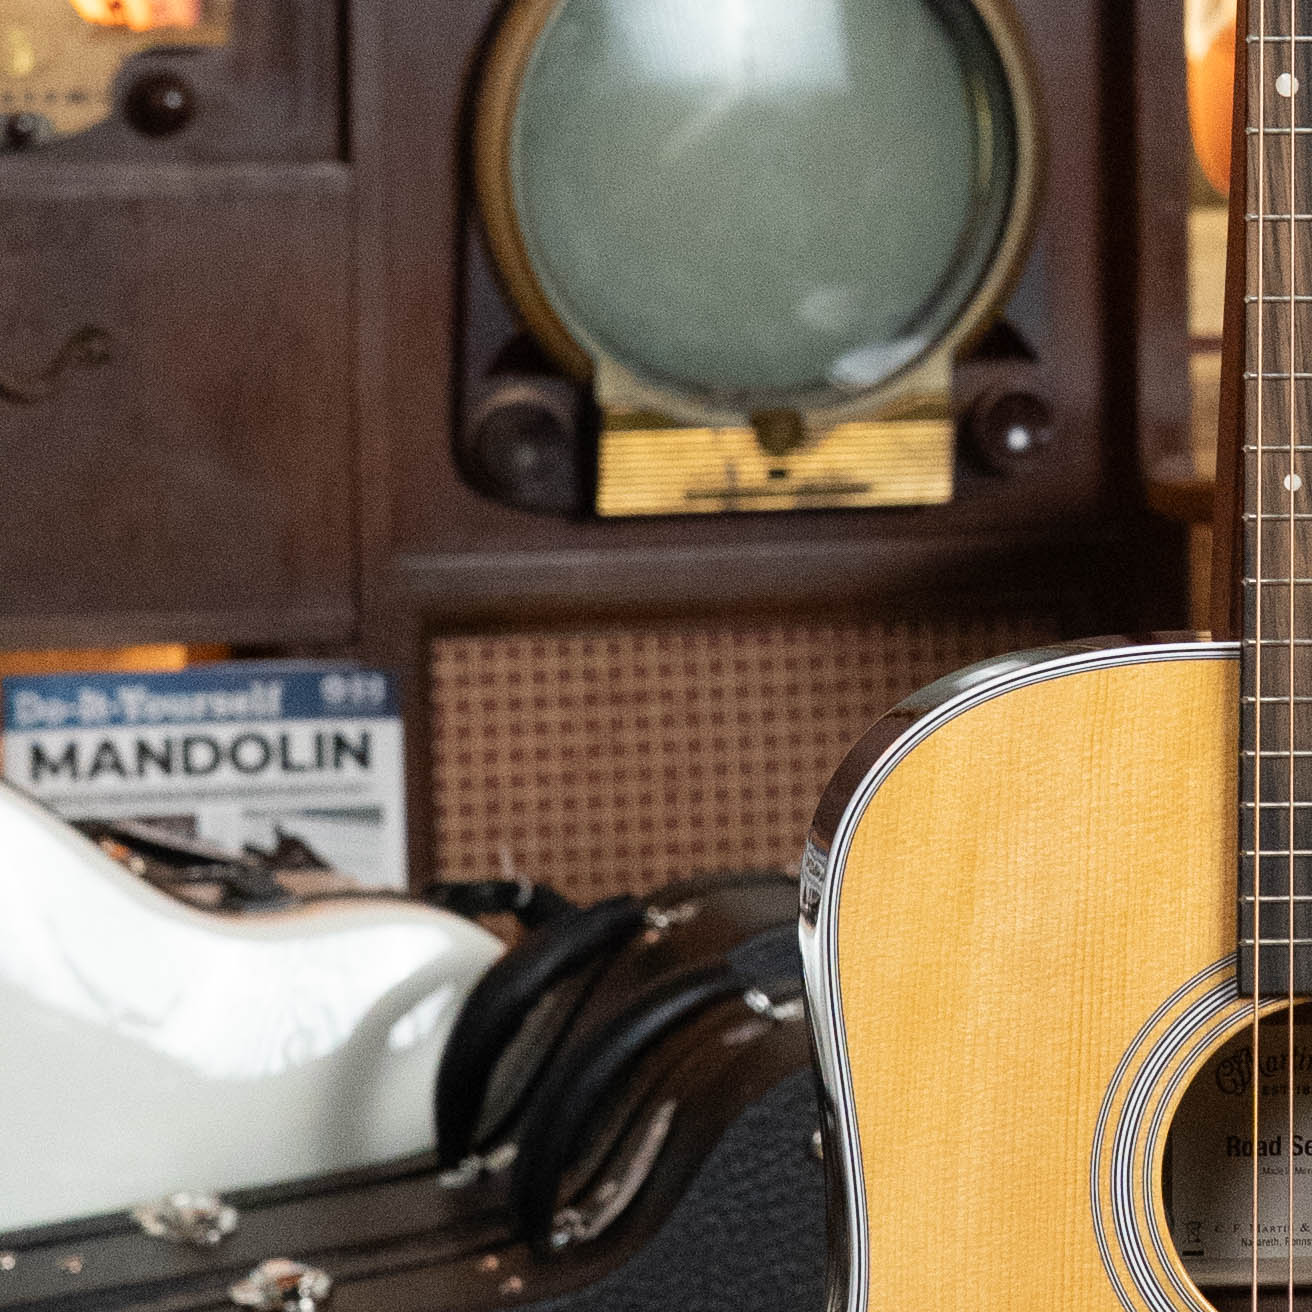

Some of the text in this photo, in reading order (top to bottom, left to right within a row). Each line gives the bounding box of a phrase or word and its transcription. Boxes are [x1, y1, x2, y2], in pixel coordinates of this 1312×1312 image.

[30, 729, 372, 783] MANDOLIN
[1262, 1085, 1289, 1096] EST
[1226, 1134, 1282, 1158] Road
[1241, 1237, 1282, 1248] Naareth,
